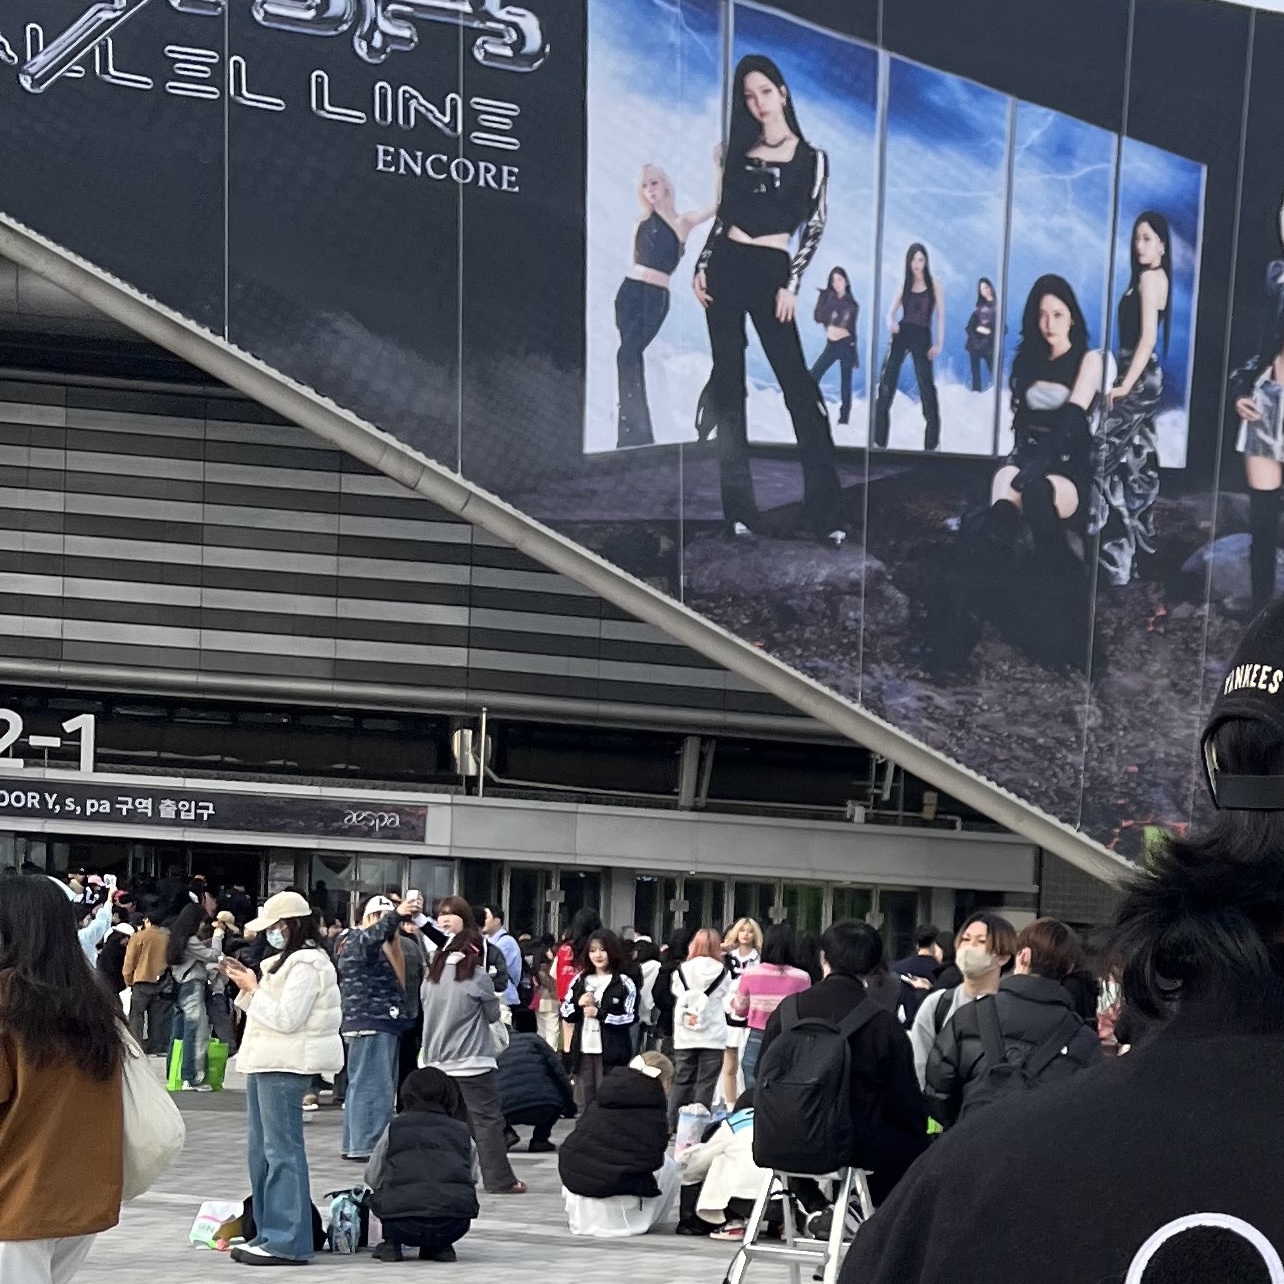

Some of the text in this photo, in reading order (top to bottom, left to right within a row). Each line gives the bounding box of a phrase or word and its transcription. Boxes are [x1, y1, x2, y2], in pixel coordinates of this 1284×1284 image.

[310, 70, 521, 150] LINE
[375, 144, 520, 192] ENCORE
[0, 707, 95, 773] 2-1
[43, 792, 61, 813] Y,
[65, 797, 82, 815] s,
[86, 798, 110, 816] pa
[115, 796, 152, 818] 구역
[159, 799, 215, 821] 출입구
